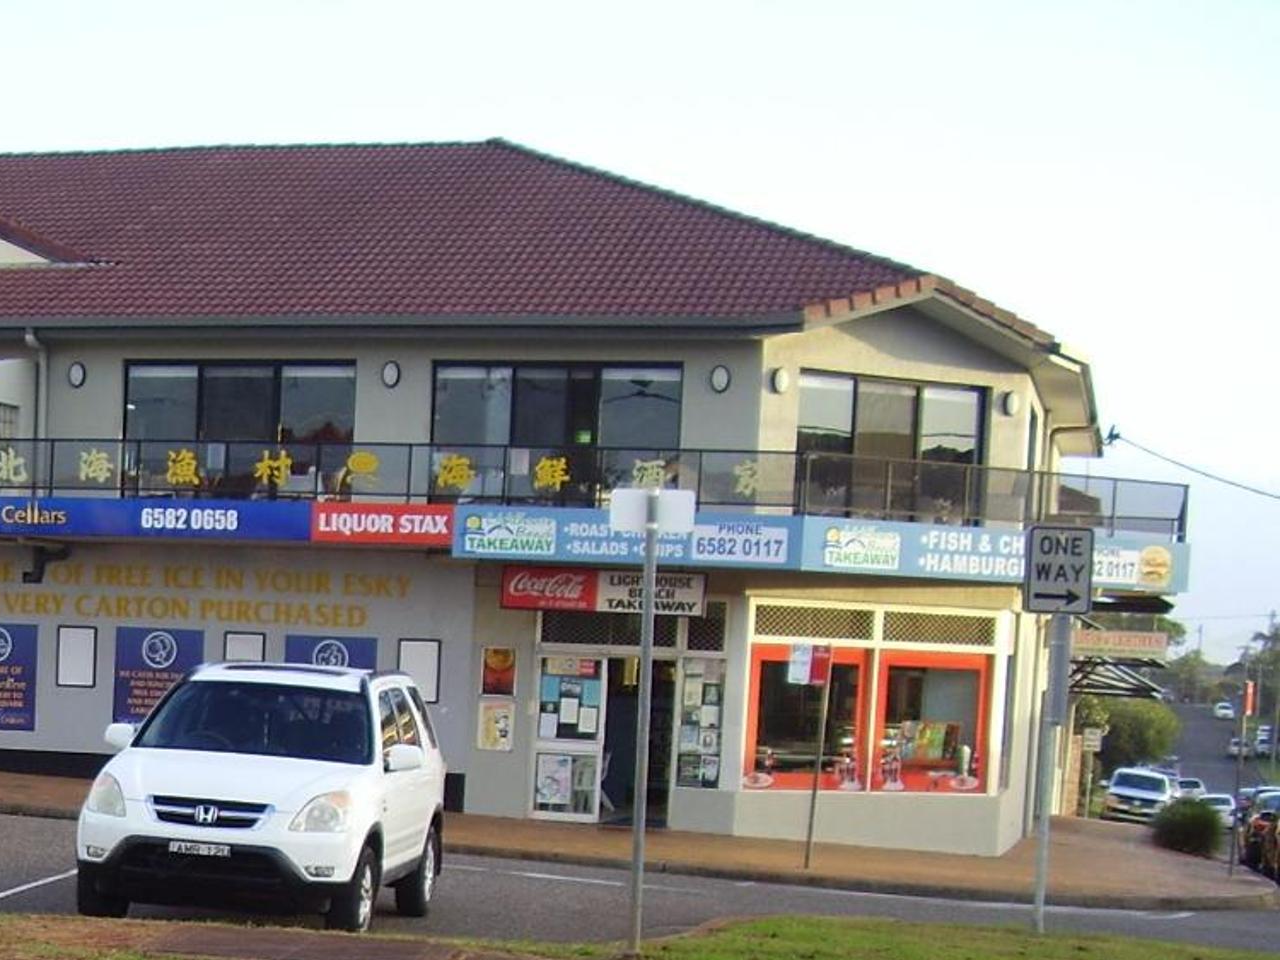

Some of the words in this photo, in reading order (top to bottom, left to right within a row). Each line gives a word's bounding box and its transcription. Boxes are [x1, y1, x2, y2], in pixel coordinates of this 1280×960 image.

[1, 501, 67, 525] Cellars
[140, 508, 187, 530] 6582
[191, 509, 238, 531] 0658
[319, 513, 394, 535] LIQUOR
[399, 514, 449, 535] STAX
[570, 522, 616, 538] ROAST
[718, 523, 763, 536] PHONE
[468, 536, 552, 552] TAKEAWAY
[573, 540, 628, 556] SALADS
[639, 542, 684, 558] CIPS
[696, 536, 737, 556] 6582
[743, 538, 784, 558] 0117
[928, 530, 971, 551] FISH
[978, 534, 992, 552] &
[1039, 535, 1084, 556] ONE
[827, 550, 898, 567] TAKEAWAY
[925, 553, 1025, 577] HAMBURG
[51, 562, 83, 586] OF
[94, 563, 153, 588] FREE
[164, 564, 204, 589] ICE
[215, 566, 244, 590] IN
[256, 568, 332, 595] YOUR
[344, 572, 413, 598] ESKY
[1034, 563, 1086, 583] WAY
[74, 592, 192, 620] CARTON
[200, 597, 368, 629] PURCHASED
